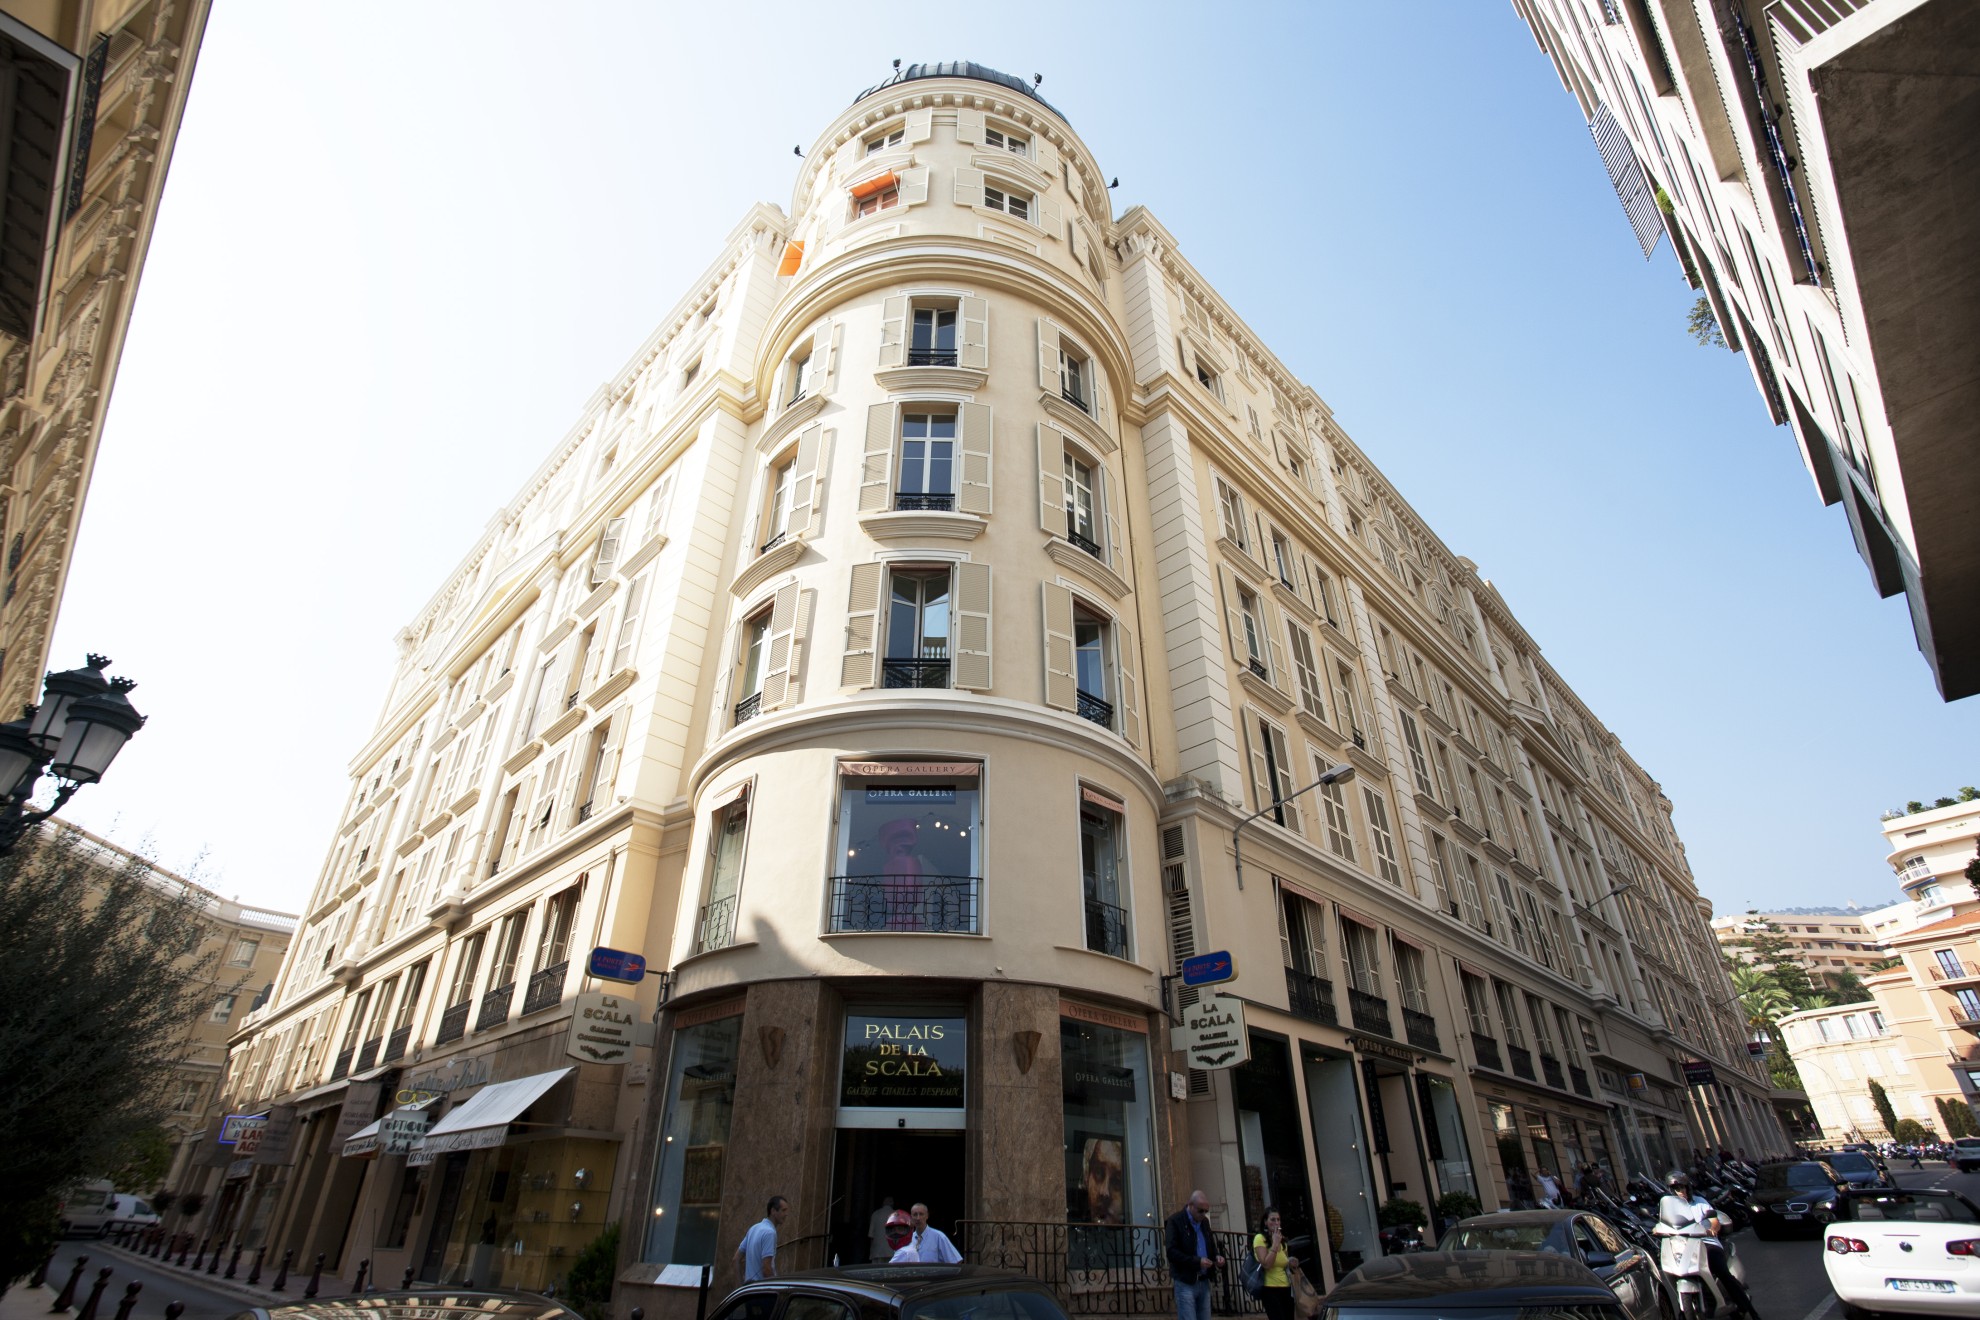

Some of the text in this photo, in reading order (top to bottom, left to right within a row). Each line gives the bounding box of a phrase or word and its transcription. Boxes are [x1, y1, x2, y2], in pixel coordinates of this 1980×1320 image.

[862, 765, 900, 774] OPERA
[868, 789, 954, 798] OPERA GALLERY
[602, 996, 618, 1009] LA
[1202, 1003, 1218, 1014] LA
[583, 1007, 633, 1025] SCALA
[1068, 1005, 1137, 1029] OPERA GALLERY
[1190, 1013, 1235, 1030] SCALA
[864, 1024, 944, 1040] PALAIS
[880, 1044, 928, 1056] DE LA
[865, 1060, 943, 1077] SCALA
[1075, 1072, 1132, 1089] OPERA GALLERY
[846, 1086, 959, 1096] GALERIE CHARLES DESPEAUX
